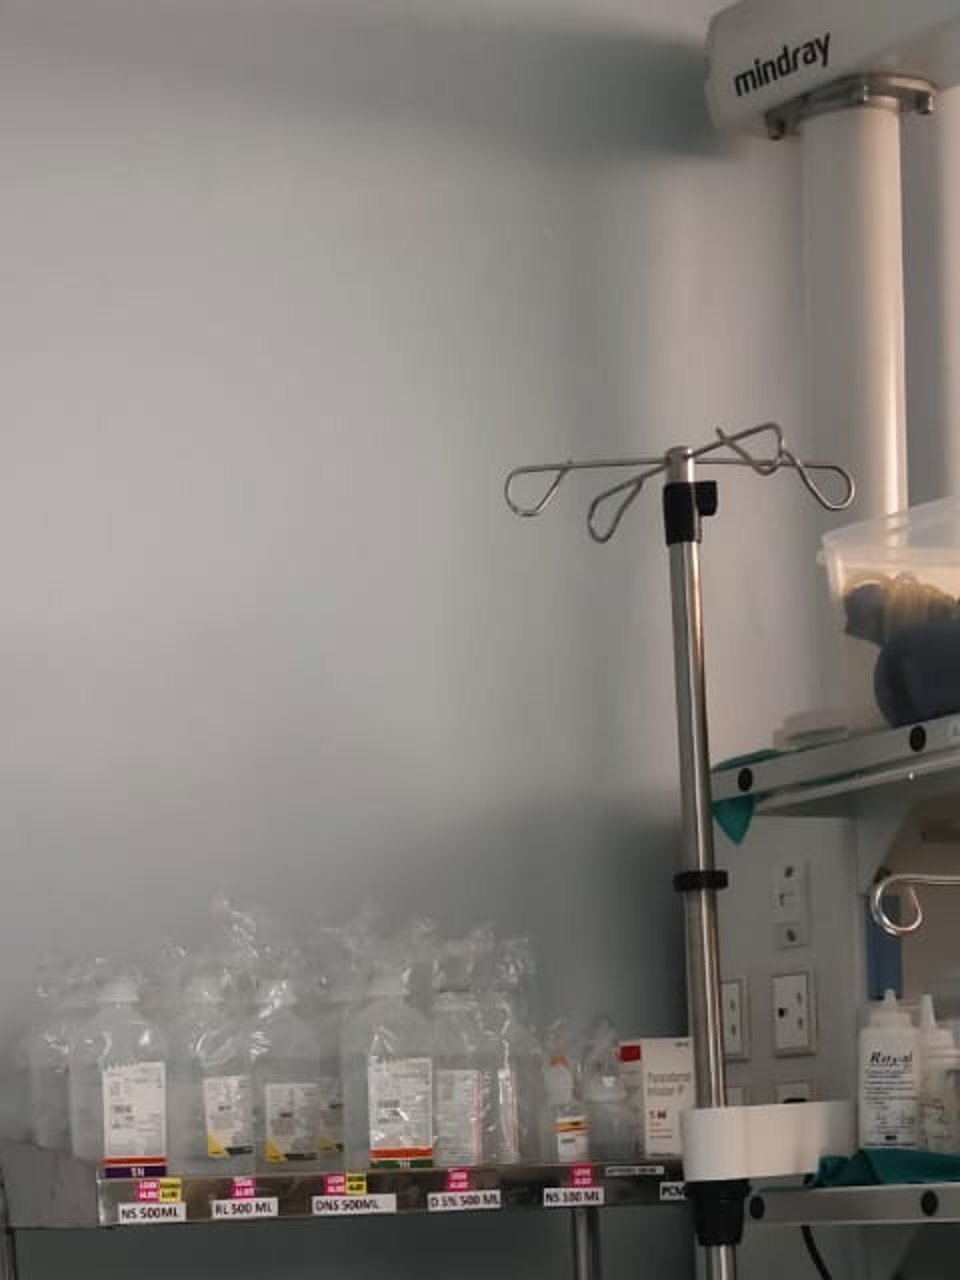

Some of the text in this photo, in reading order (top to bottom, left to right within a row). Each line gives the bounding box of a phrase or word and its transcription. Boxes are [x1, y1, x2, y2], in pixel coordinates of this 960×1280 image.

[734, 32, 831, 97] mindray
[545, 1193, 559, 1202] NS
[121, 1206, 179, 1219] NS 500ML
[215, 1202, 273, 1216] RL 500 ML
